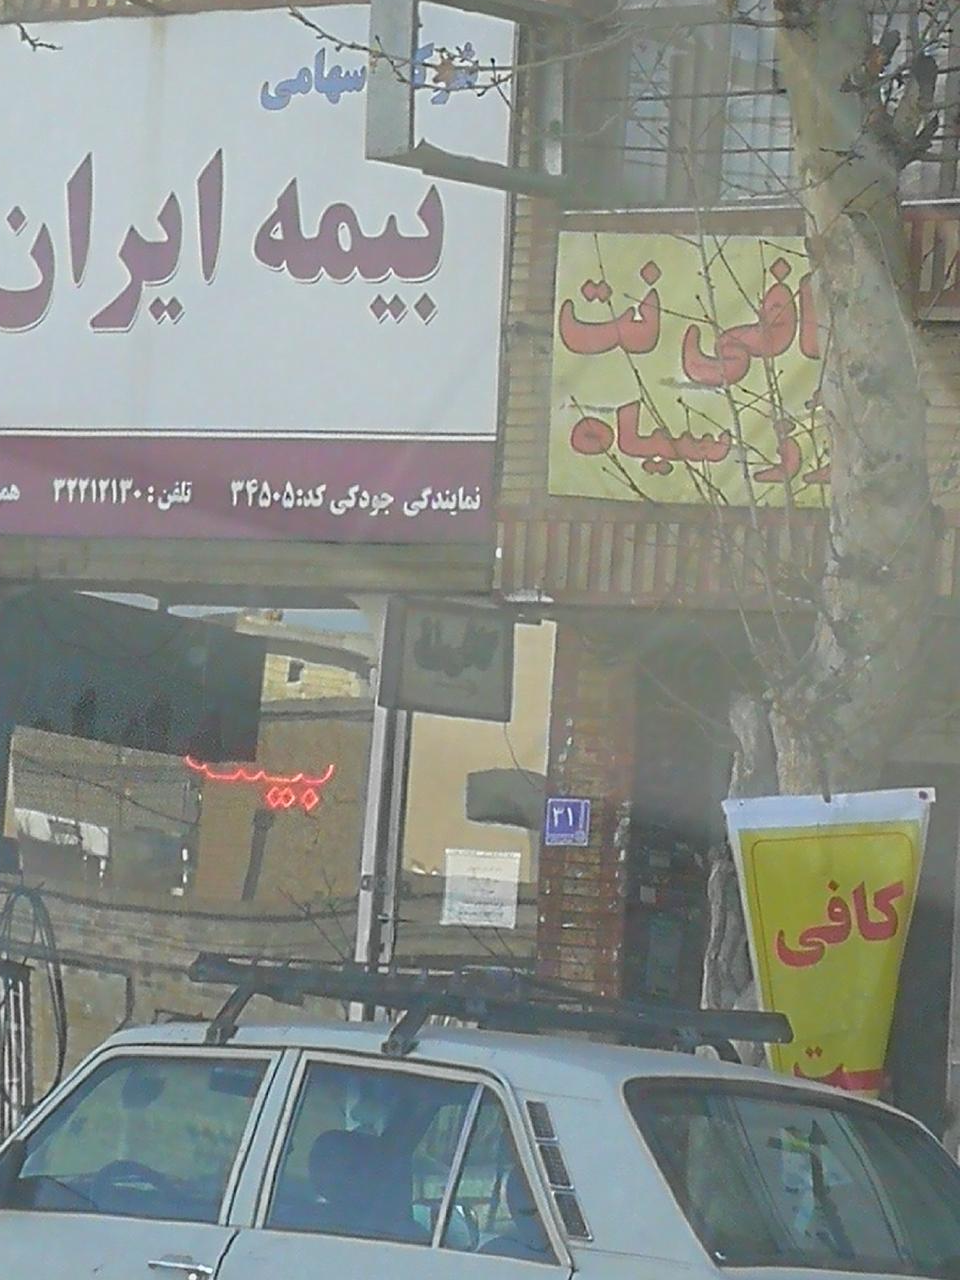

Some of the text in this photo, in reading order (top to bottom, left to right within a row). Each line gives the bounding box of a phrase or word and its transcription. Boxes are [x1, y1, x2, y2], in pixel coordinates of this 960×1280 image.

[260, 47, 368, 111] سهامی
[251, 175, 446, 327] بیمه
[558, 256, 821, 387] افی نت
[402, 485, 482, 517] نمایندگی
[774, 879, 906, 969] کافی
